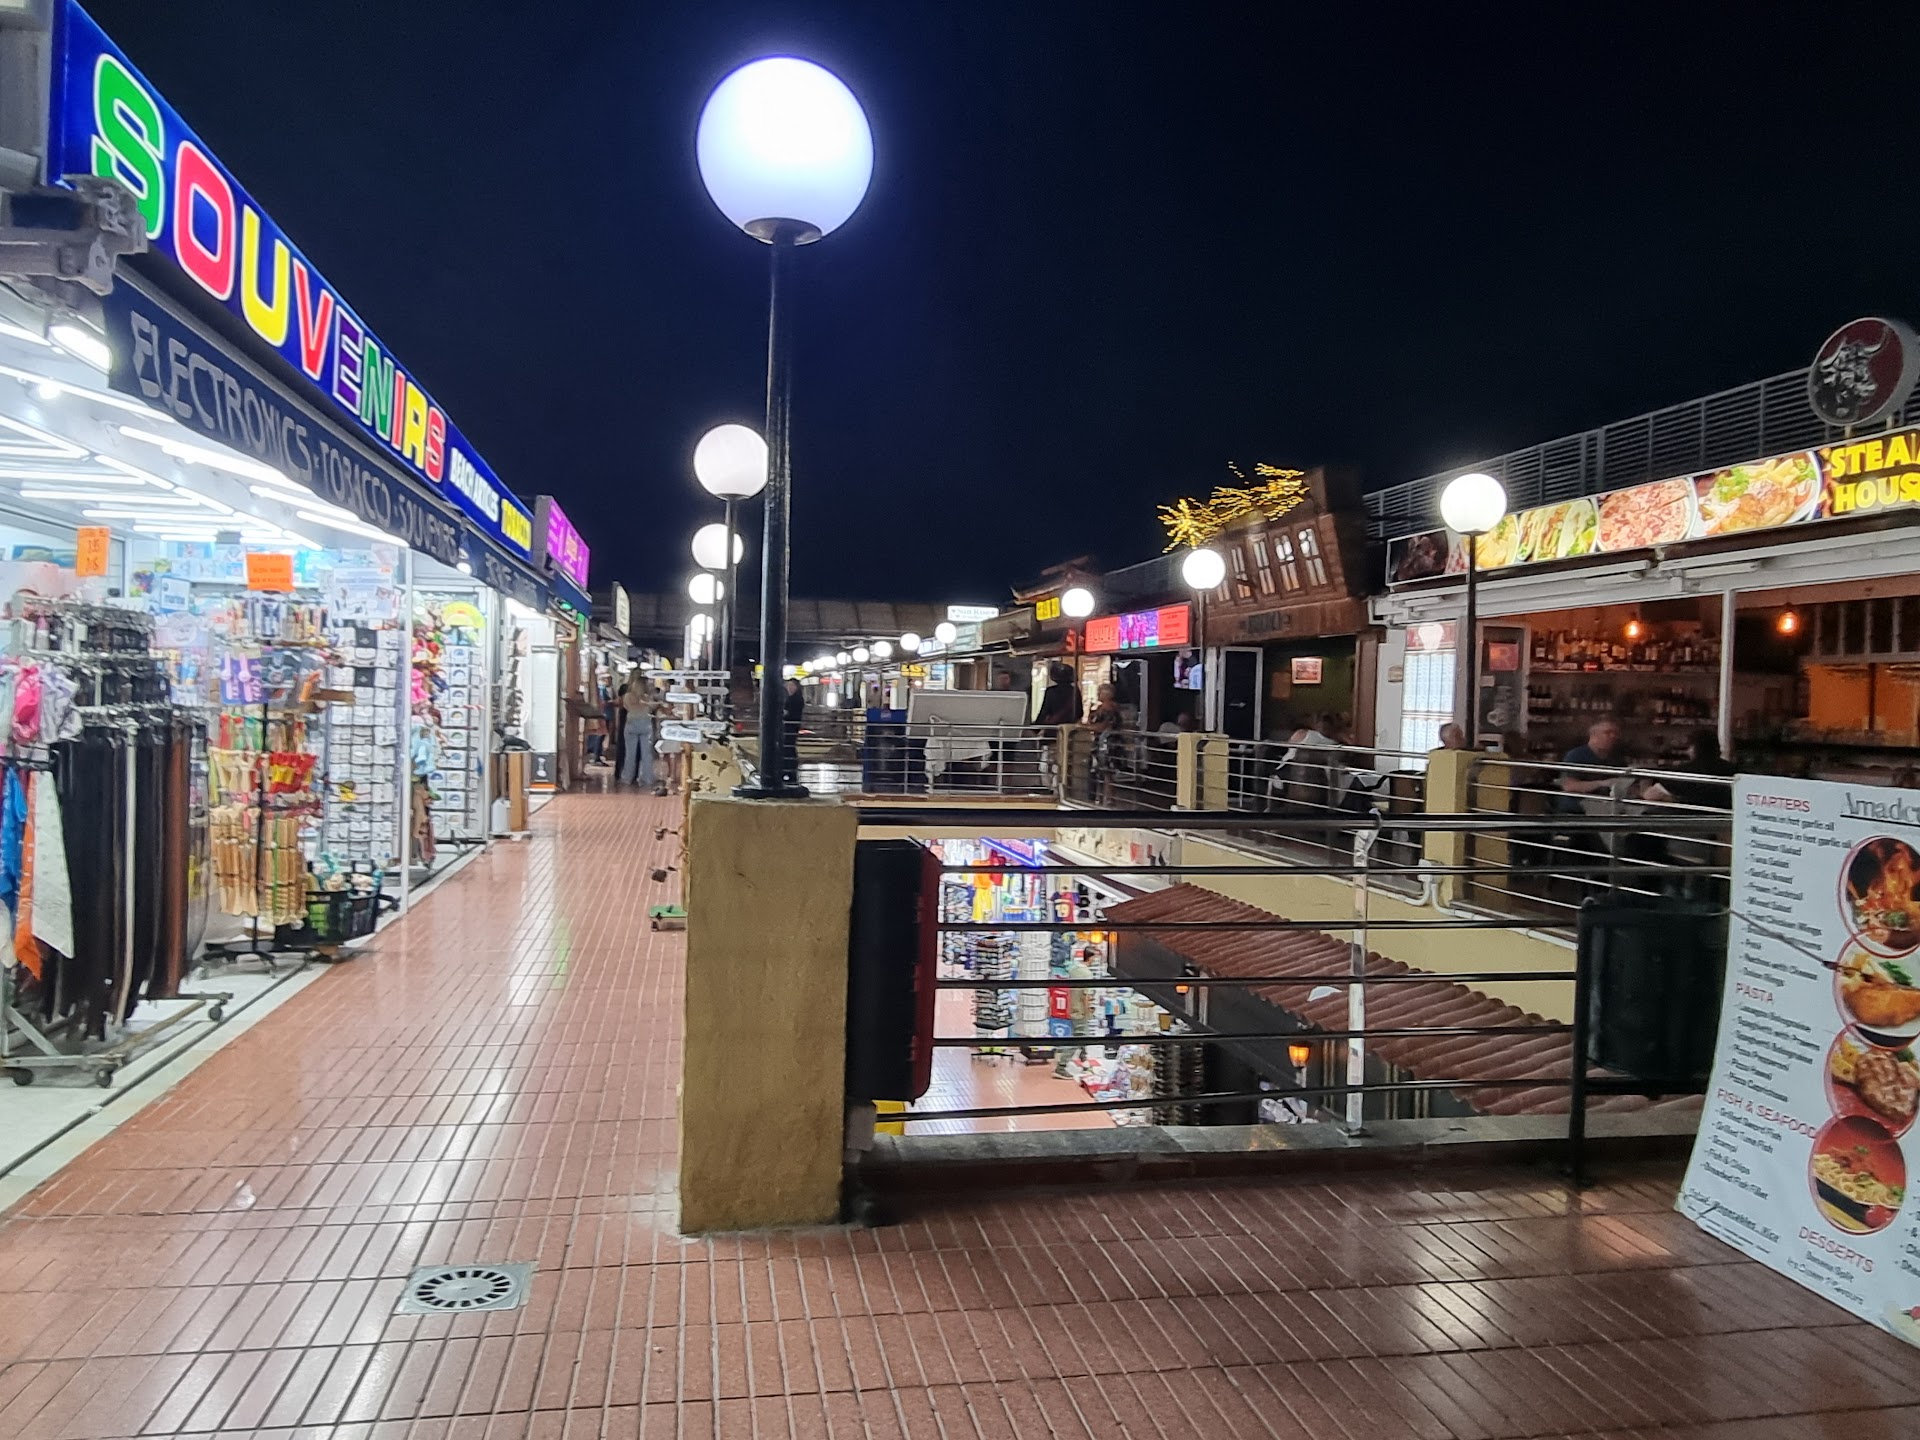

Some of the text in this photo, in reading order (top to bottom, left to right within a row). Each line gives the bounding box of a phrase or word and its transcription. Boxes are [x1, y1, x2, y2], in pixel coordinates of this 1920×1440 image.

[91, 53, 446, 483] SOUVENIRS
[130, 310, 313, 483] ELECTRONICS
[319, 440, 392, 529] TOBACCO
[1745, 793, 1810, 812] STARTERS
[1736, 982, 1774, 1002] PASTA
[1717, 1087, 1743, 1109] FISH
[1744, 1100, 1754, 1114] &
[1798, 1226, 1874, 1273] DESSERTS
